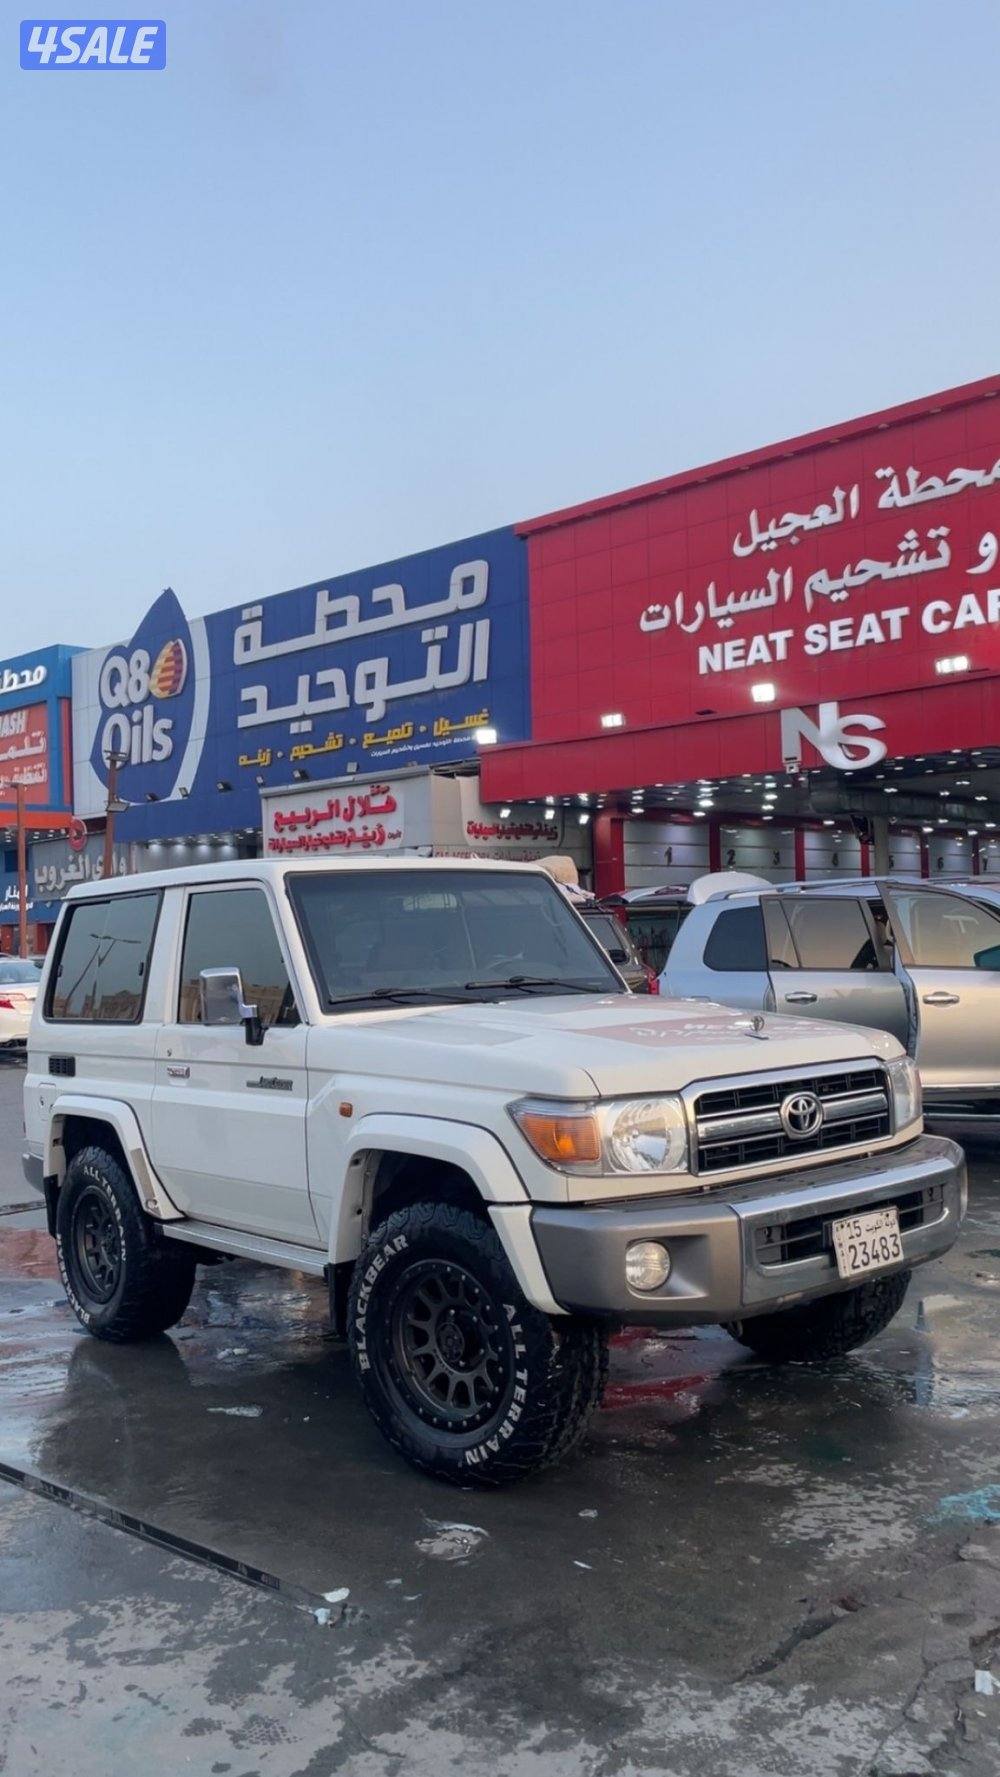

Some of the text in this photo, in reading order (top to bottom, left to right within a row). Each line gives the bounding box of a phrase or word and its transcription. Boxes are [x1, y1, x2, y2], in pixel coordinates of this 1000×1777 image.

[733, 484, 859, 557] العجيل
[640, 526, 998, 633] و تشحيم السيارات
[233, 559, 489, 665] محطة
[698, 629, 794, 674] NEAT
[803, 606, 910, 656] SEAT
[0, 665, 47, 695] محط
[100, 649, 150, 708] Q8
[237, 618, 490, 734] التوحيد
[0, 709, 27, 738] ASH
[102, 704, 173, 771] Oils
[363, 721, 413, 749] تلميع
[433, 708, 490, 737] غسيل
[0, 730, 47, 761] تلم
[290, 732, 343, 761] تشحيم
[274, 799, 340, 833] الربيع
[727, 849, 736, 865] 2
[846, 1219, 862, 1240] 15
[848, 1233, 900, 1270] 23483
[355, 1234, 409, 1371] BLACKBEAR
[465, 1303, 528, 1466] ALL TERRAIN
